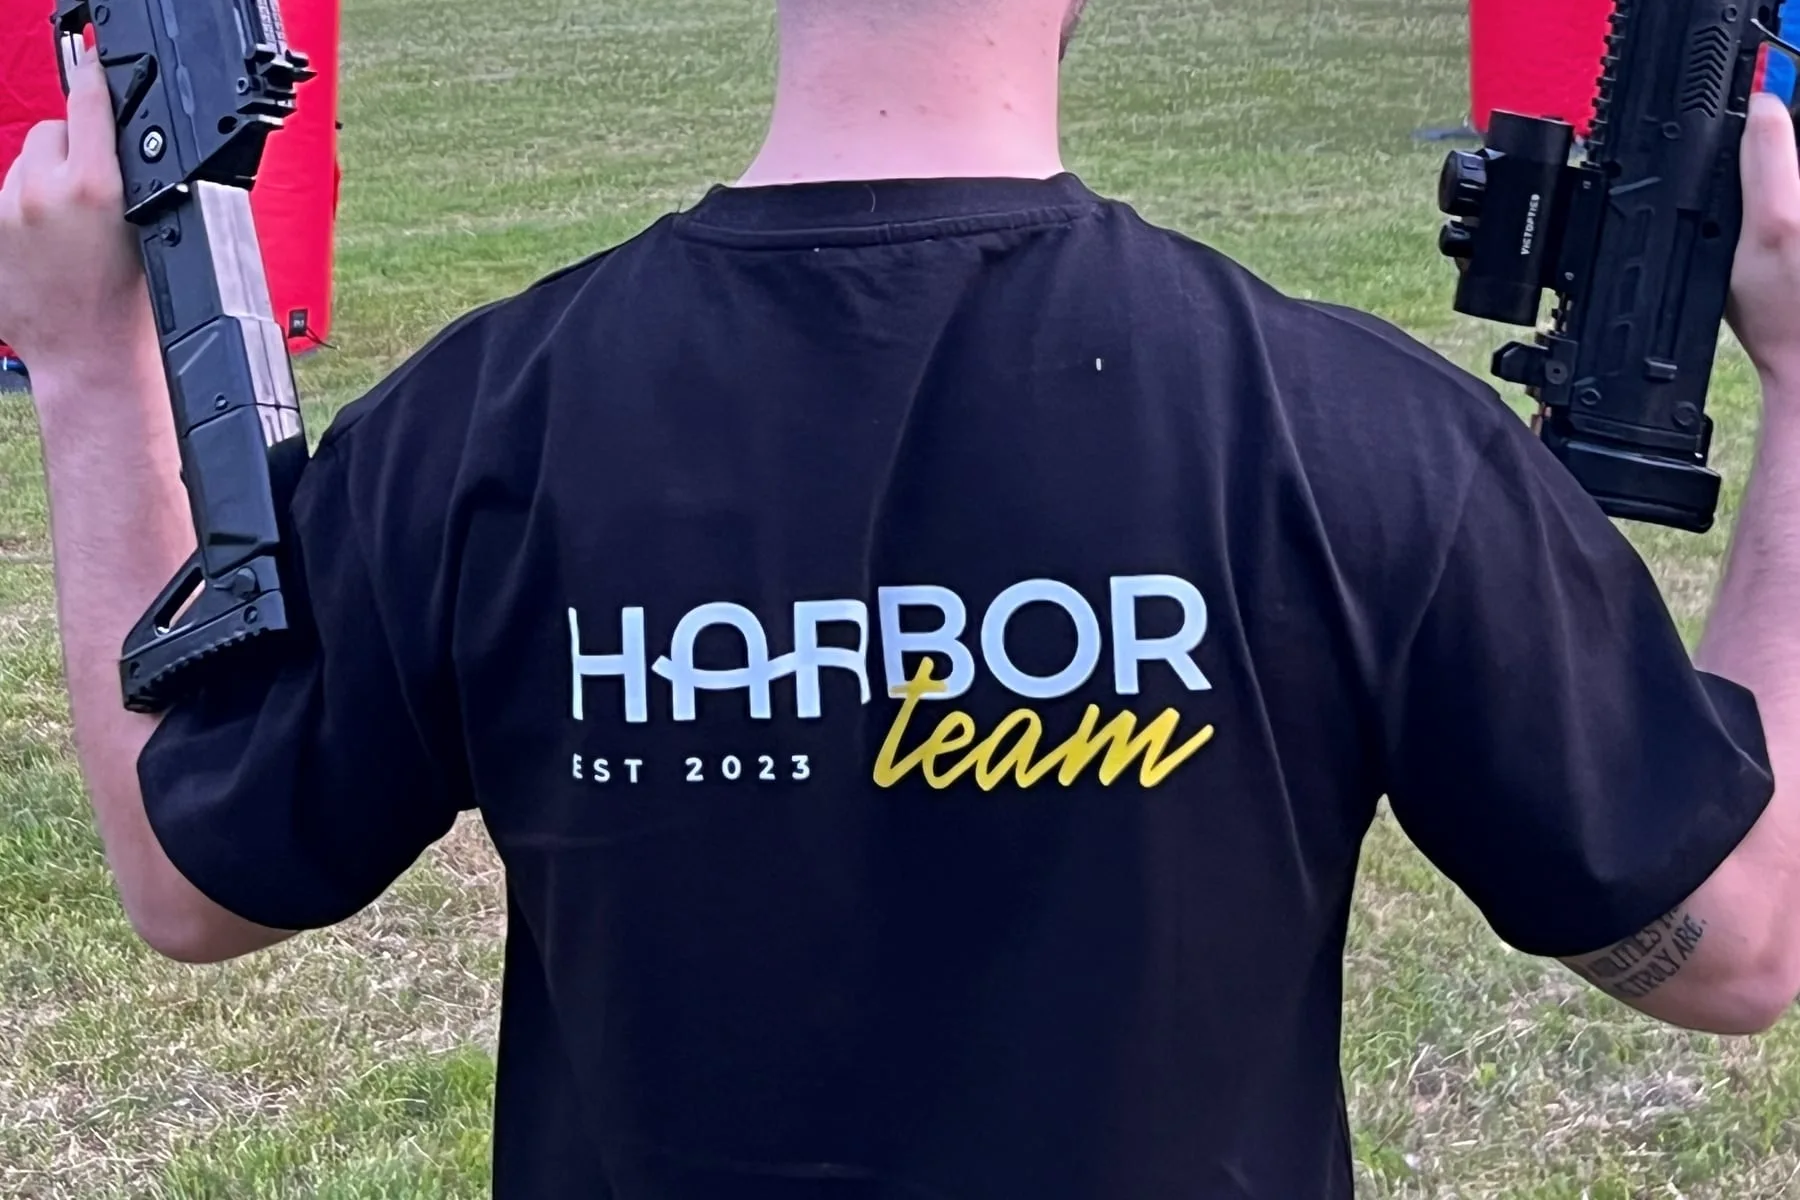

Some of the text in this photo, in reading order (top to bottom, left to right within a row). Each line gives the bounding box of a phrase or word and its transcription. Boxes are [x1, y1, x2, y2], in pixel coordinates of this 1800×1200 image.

[568, 574, 1212, 723] HARBOR
[572, 752, 810, 783] EST 2023
[873, 656, 1214, 792] team
